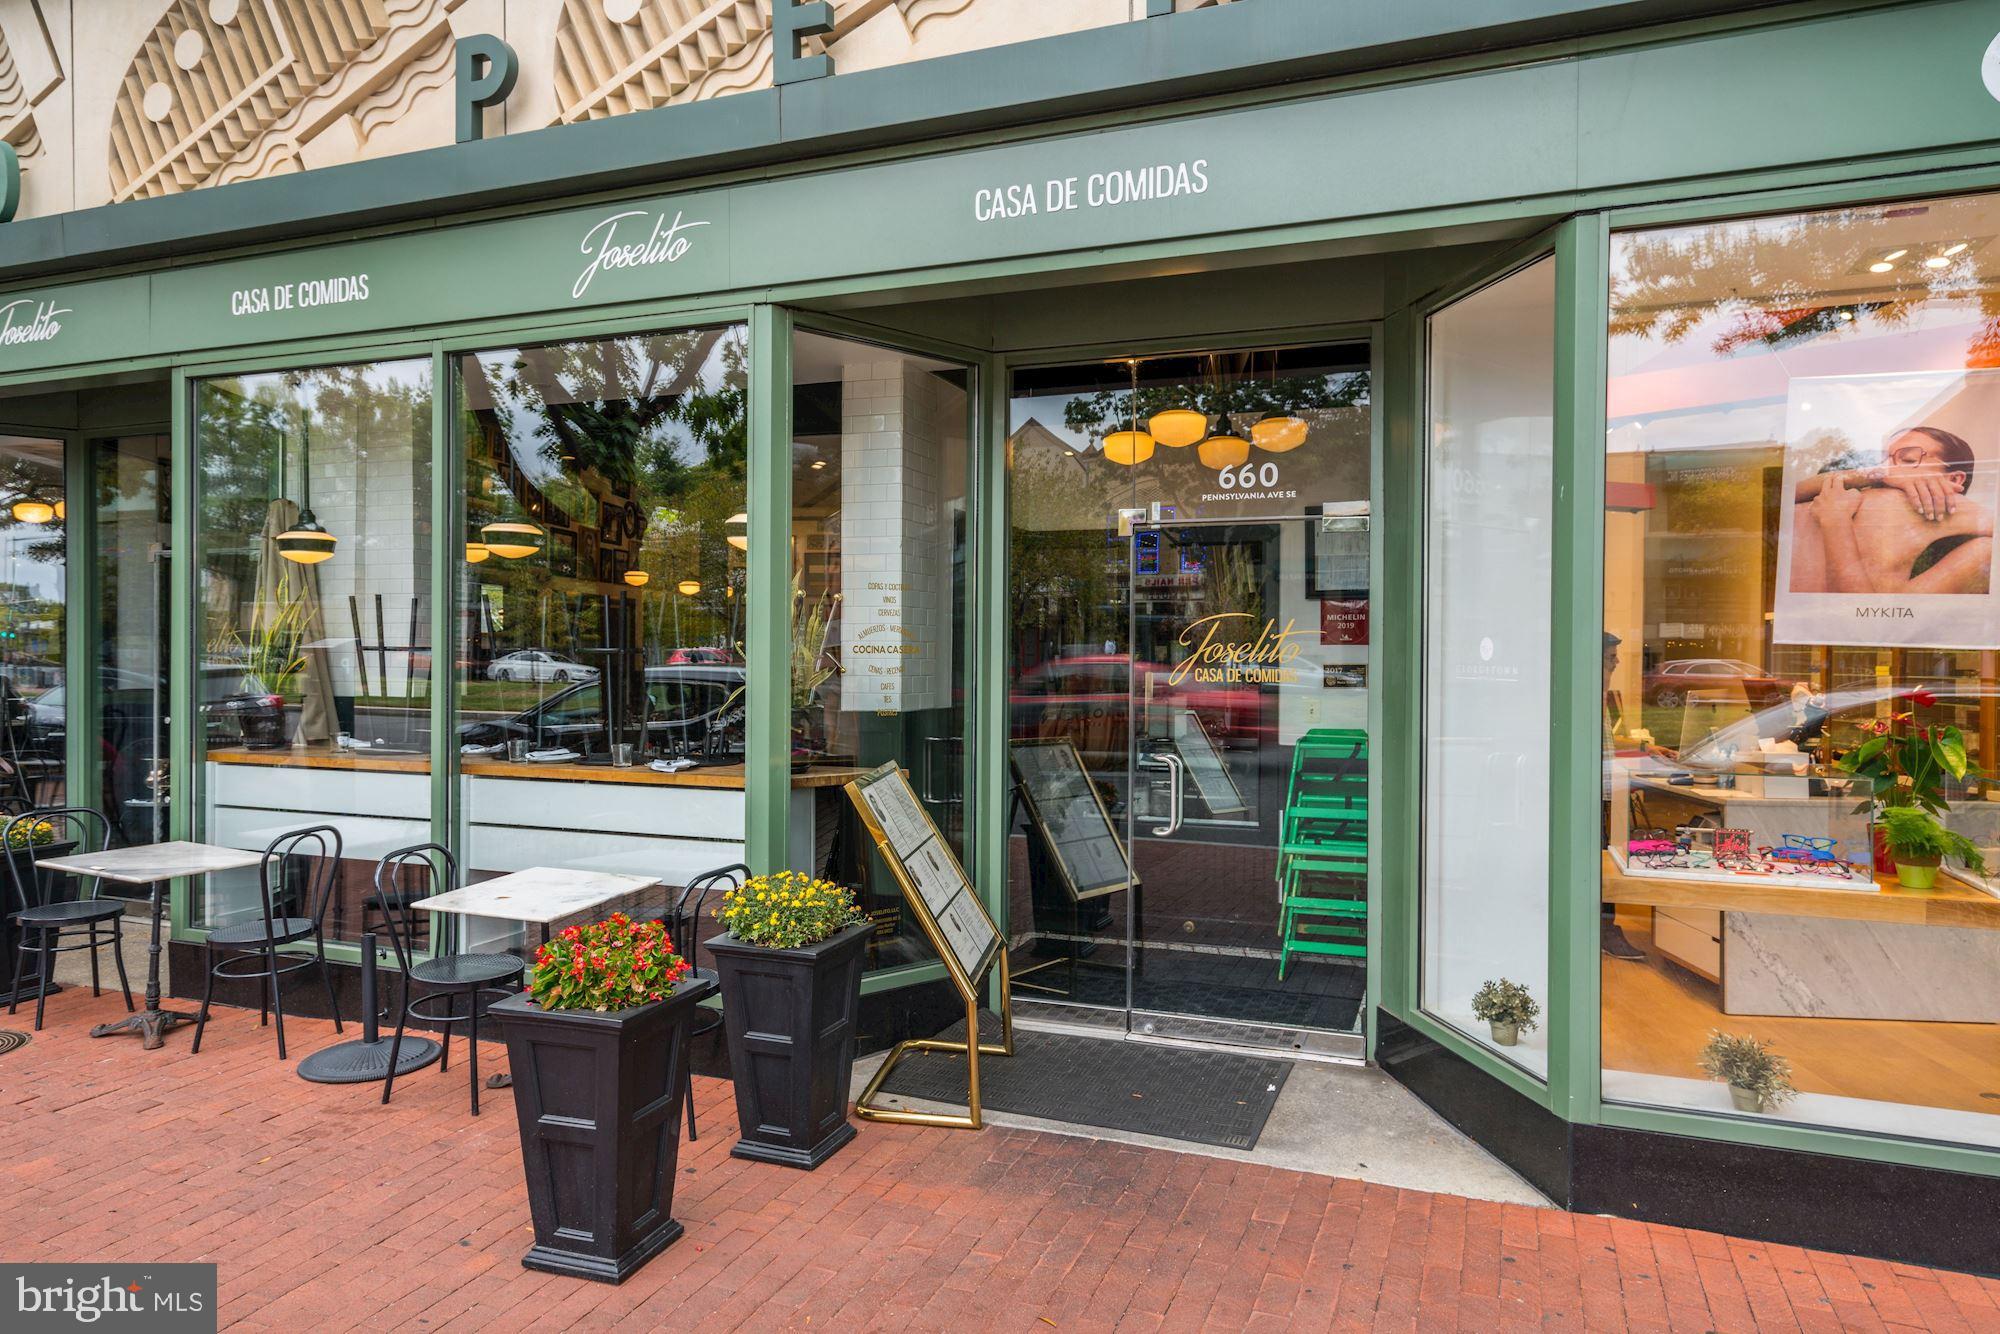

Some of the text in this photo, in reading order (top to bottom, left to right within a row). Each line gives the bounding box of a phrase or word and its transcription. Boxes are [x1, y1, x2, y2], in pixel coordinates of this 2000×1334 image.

[974, 159, 1209, 222] CASA DE COMIDAS
[572, 210, 712, 299] Joselito
[231, 274, 370, 316] CASA DE COMIDAS
[1218, 462, 1279, 490] 660
[1201, 490, 1297, 501] PENNSYLVANIA AVE SE
[1855, 607, 1915, 618] MYKITA
[853, 645, 886, 654] COCINA
[1168, 612, 1327, 687] Joselito
[1194, 667, 1298, 683] CASA DE COMIDAS
